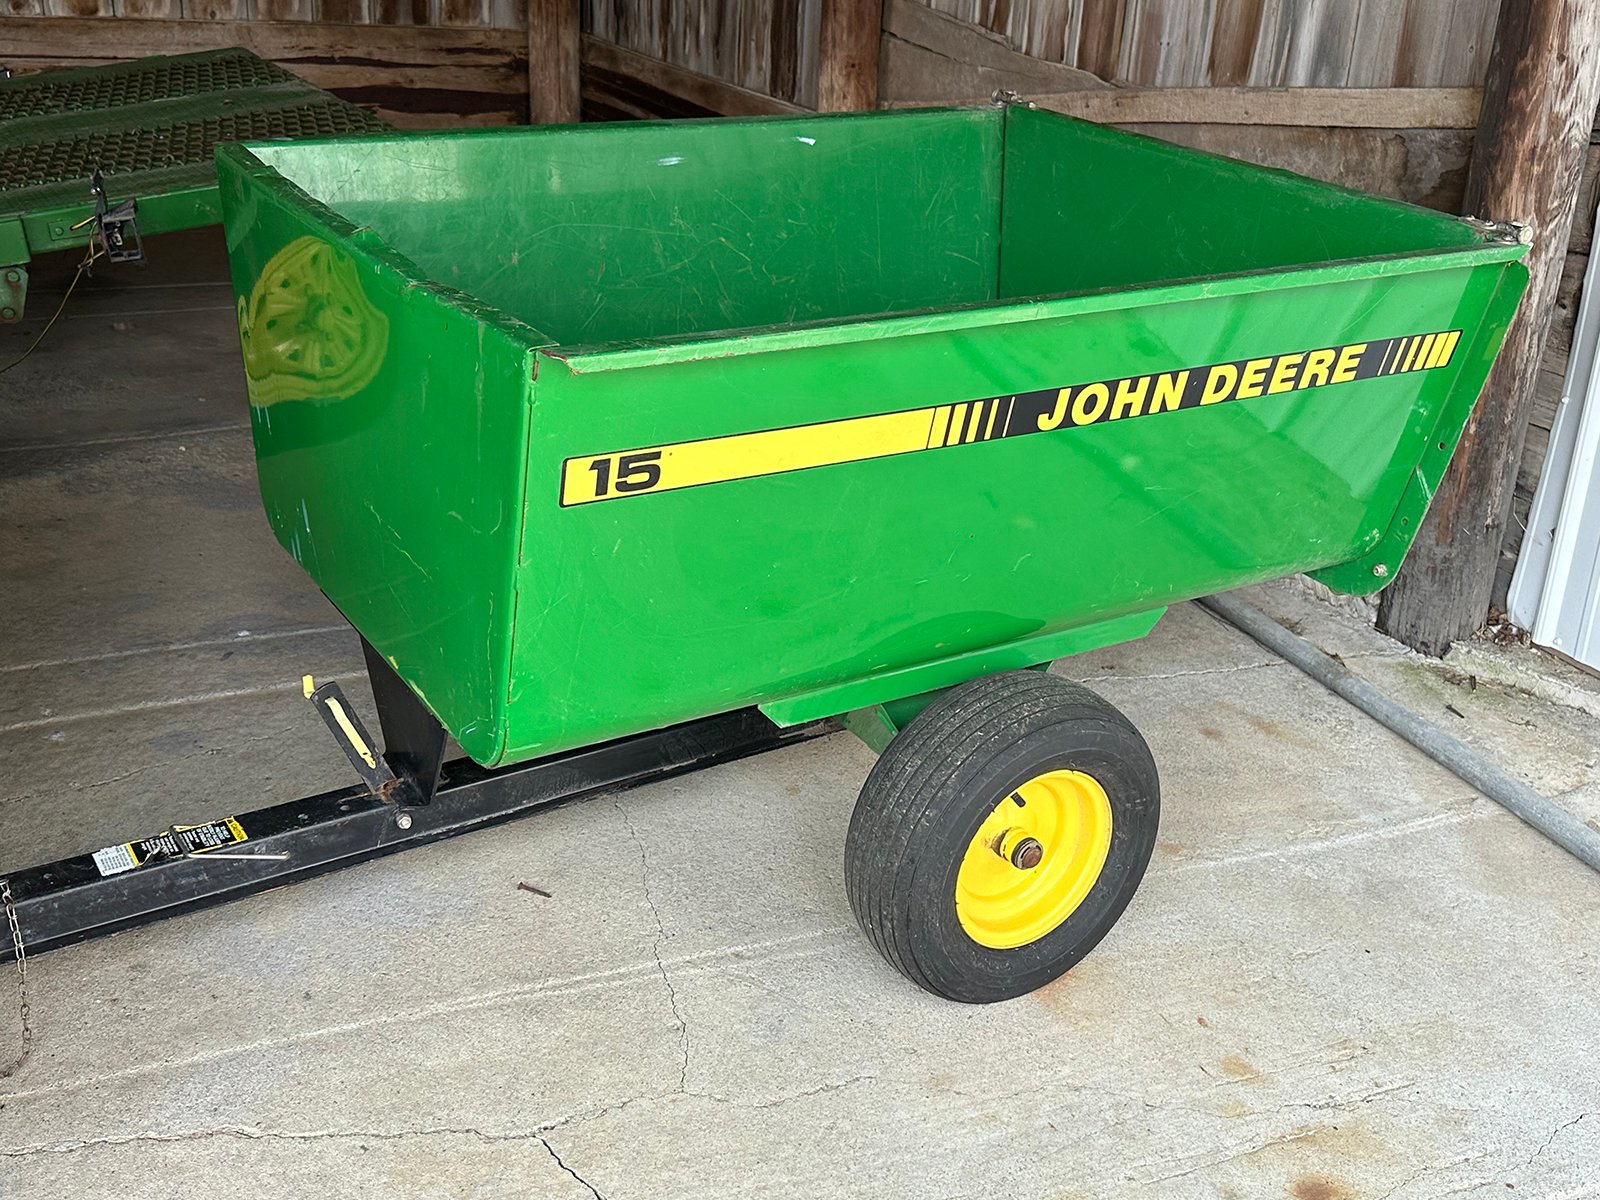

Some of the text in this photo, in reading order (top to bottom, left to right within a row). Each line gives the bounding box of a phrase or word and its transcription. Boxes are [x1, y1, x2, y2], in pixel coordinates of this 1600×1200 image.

[1037, 344, 1367, 431] JOHN DEERE
[589, 451, 662, 497] 15
